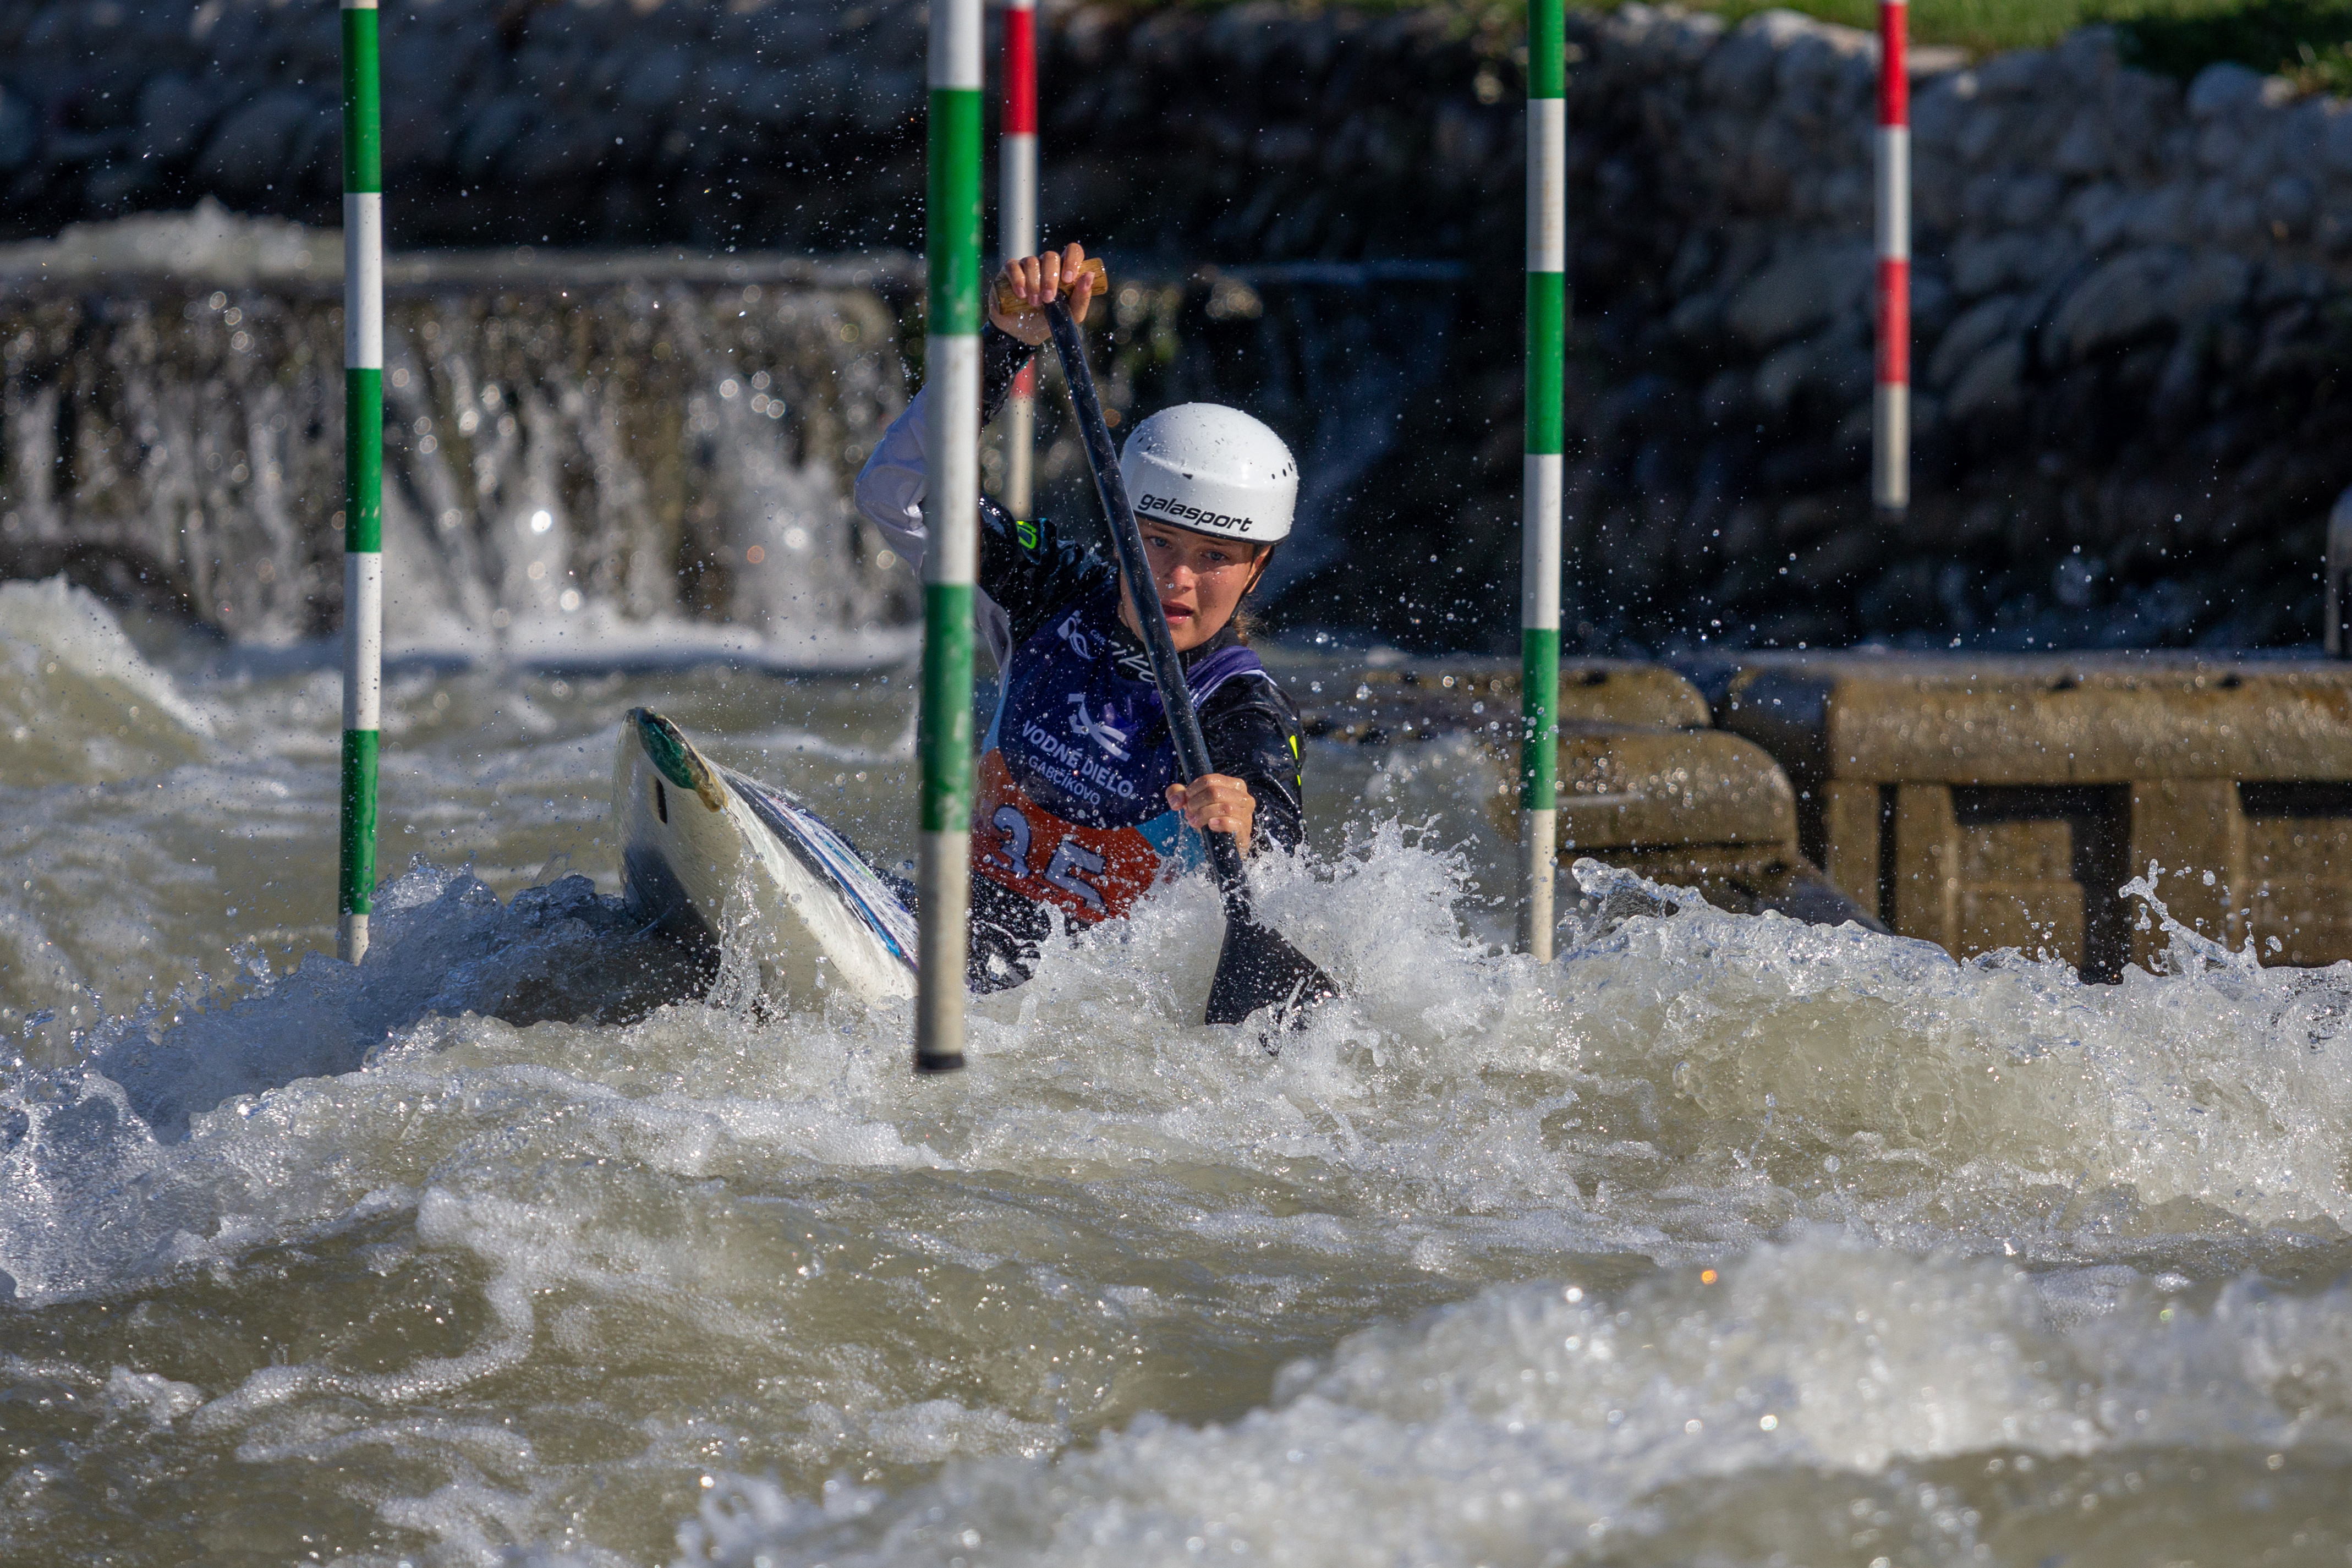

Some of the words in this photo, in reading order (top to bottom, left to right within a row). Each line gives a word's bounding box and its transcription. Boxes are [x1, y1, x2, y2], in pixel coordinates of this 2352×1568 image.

[1138, 494, 1253, 532] galasport
[1022, 720, 1083, 768] VODNÉ
[1081, 758, 1133, 797] DIELO
[1028, 755, 1100, 805] GABČÍKOVO
